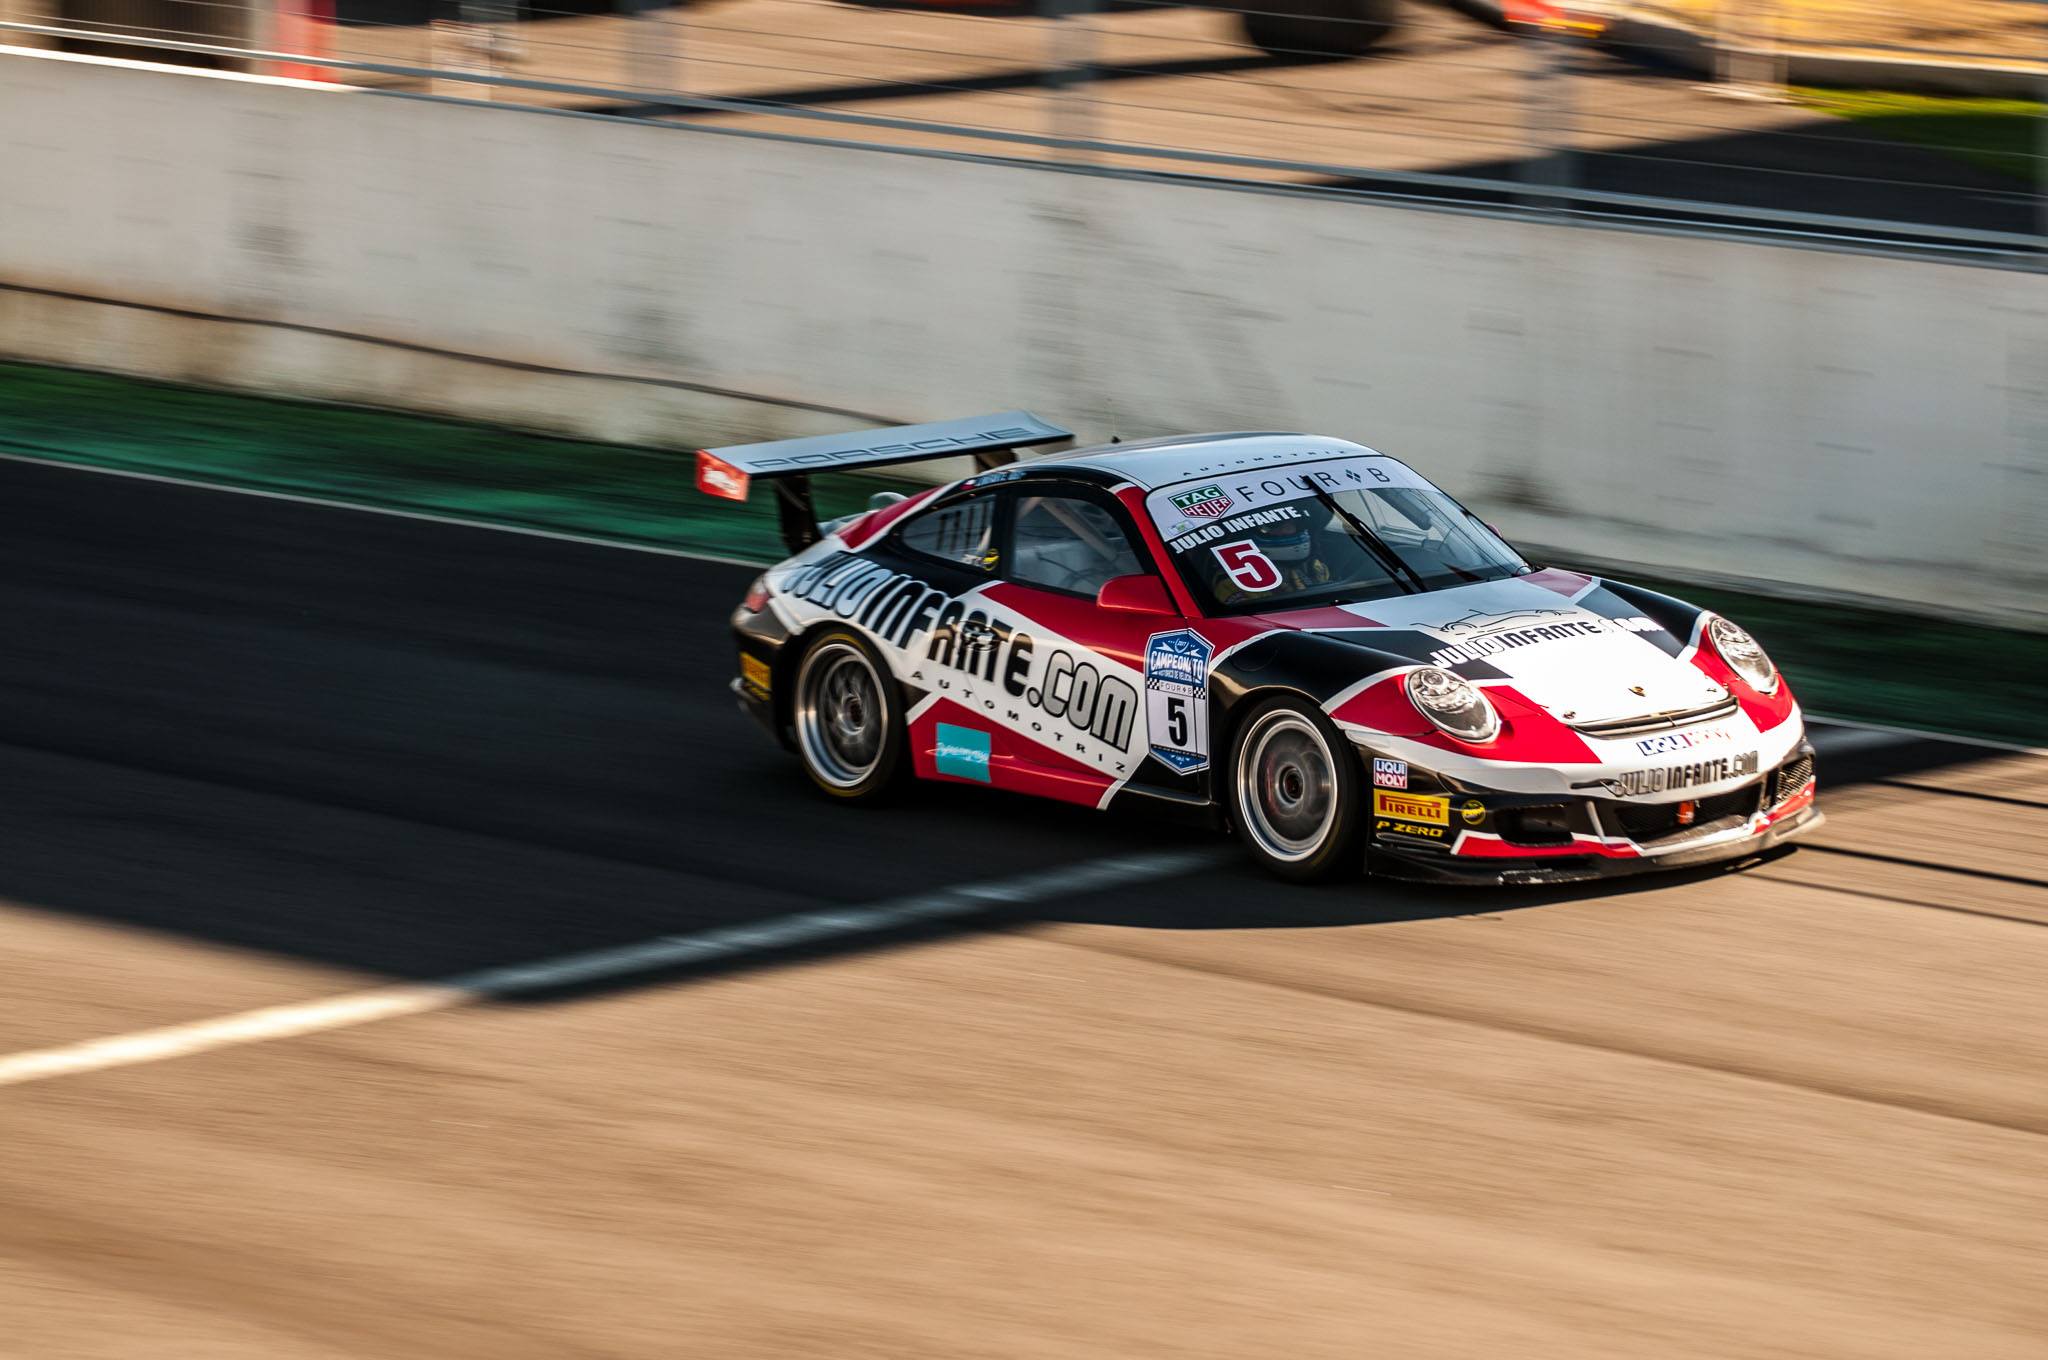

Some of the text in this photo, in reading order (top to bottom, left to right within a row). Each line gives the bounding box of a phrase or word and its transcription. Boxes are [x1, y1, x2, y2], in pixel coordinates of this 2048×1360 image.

[743, 426, 1037, 469] PORSCHE
[1183, 450, 1347, 476] AUTOMOTRIZ
[1175, 487, 1222, 505] TAG
[1236, 471, 1341, 502] FOUR
[1183, 497, 1230, 517] HEUER
[1170, 506, 1302, 554] JULIO INFANTE
[1210, 539, 1283, 592] 5
[1160, 682, 1181, 691] FOUR
[910, 670, 1126, 773] AUTOMOTRIZ
[1168, 697, 1187, 747] 5
[1376, 760, 1406, 773] LIQUI
[1375, 774, 1406, 787] MOLY
[1380, 794, 1440, 818] PIRELLI
[1376, 821, 1443, 837] P ZERO
